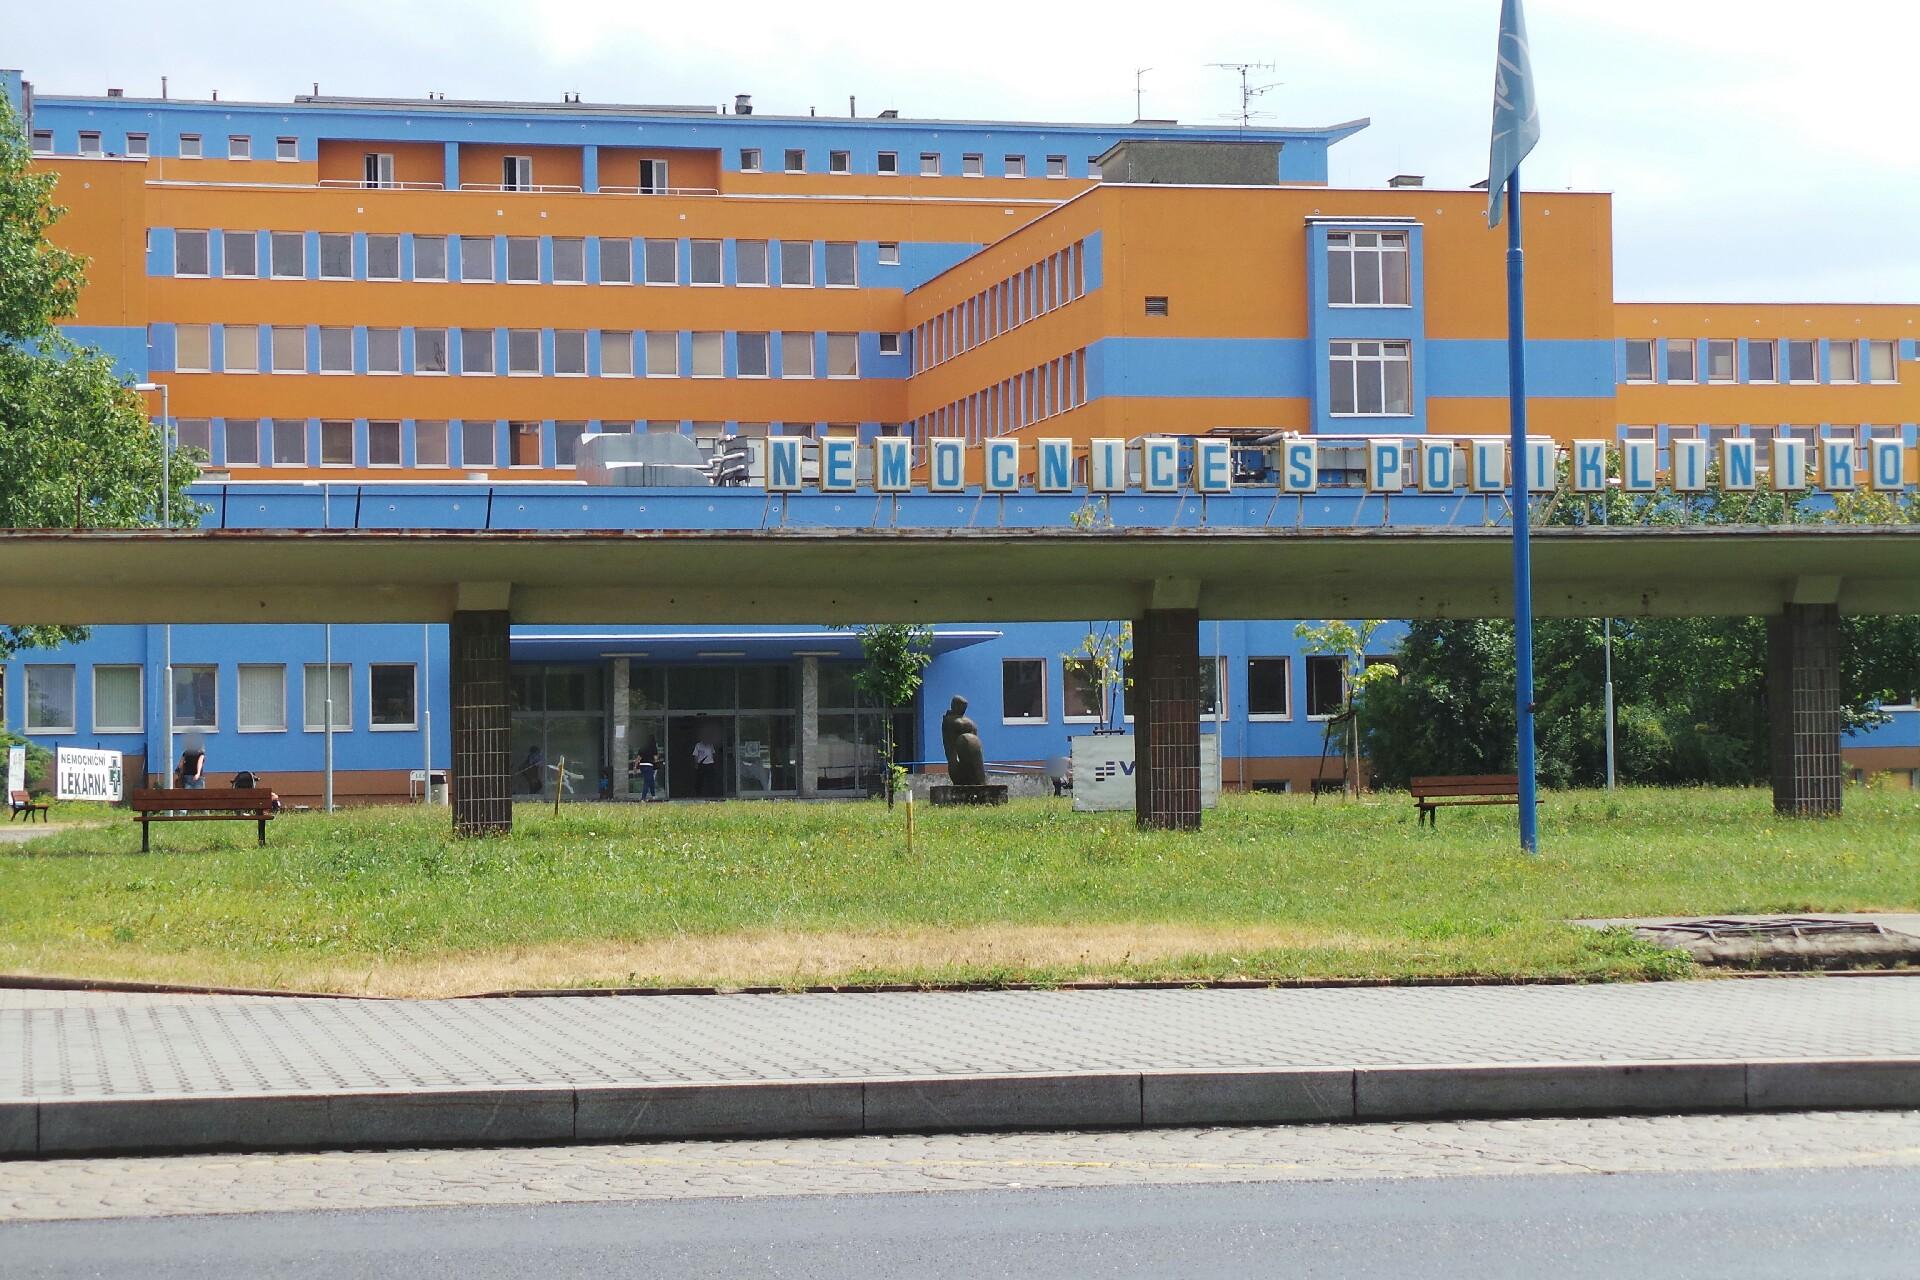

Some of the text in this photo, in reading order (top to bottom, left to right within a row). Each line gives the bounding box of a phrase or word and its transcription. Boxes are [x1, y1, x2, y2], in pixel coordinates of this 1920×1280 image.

[773, 443, 1900, 488] NEMOCNICE S POLIKLINIKO
[61, 767, 107, 796] LÉKÁRNA
